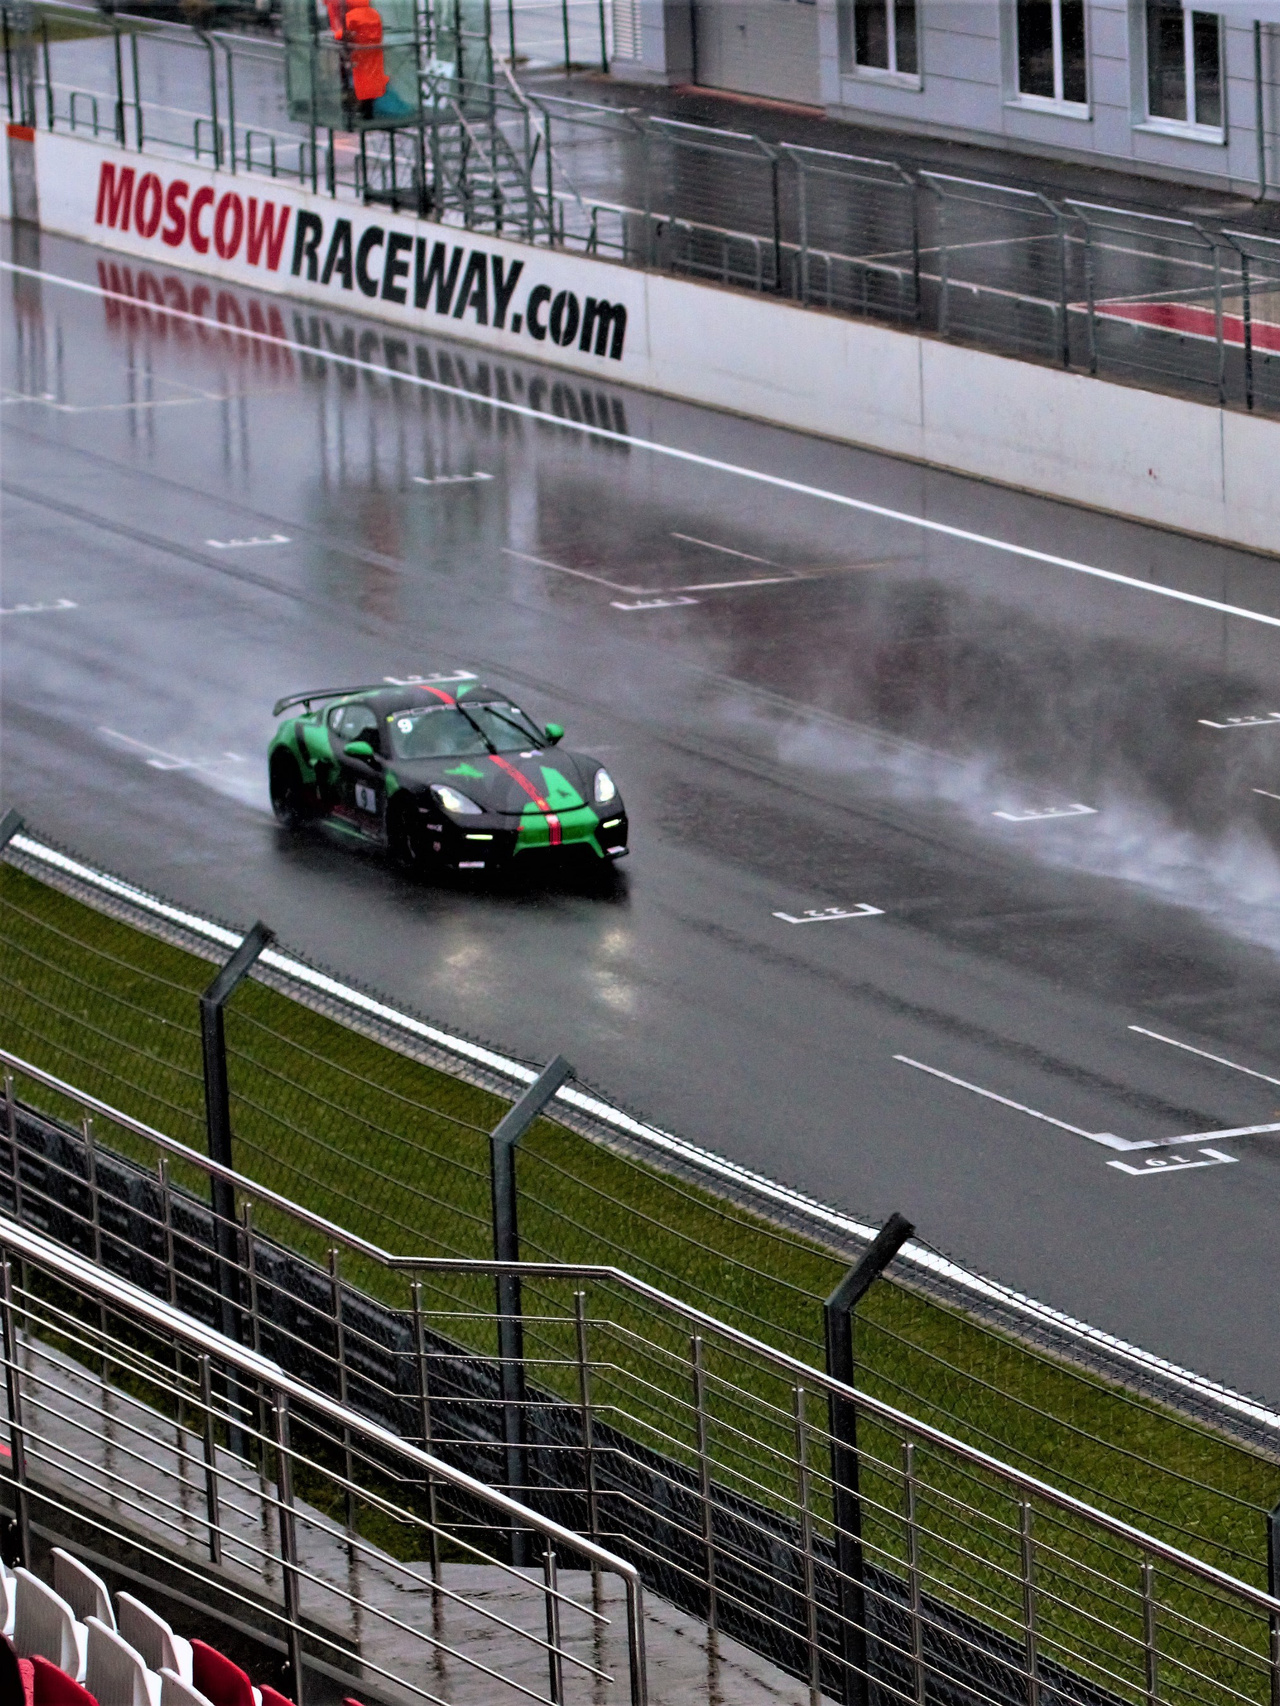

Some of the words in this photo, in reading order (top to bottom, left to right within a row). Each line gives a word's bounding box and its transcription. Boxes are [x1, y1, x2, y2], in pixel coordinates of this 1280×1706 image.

[95, 161, 291, 272] MOSCOW
[292, 210, 628, 361] RACEWAY.com
[397, 718, 414, 735] 9
